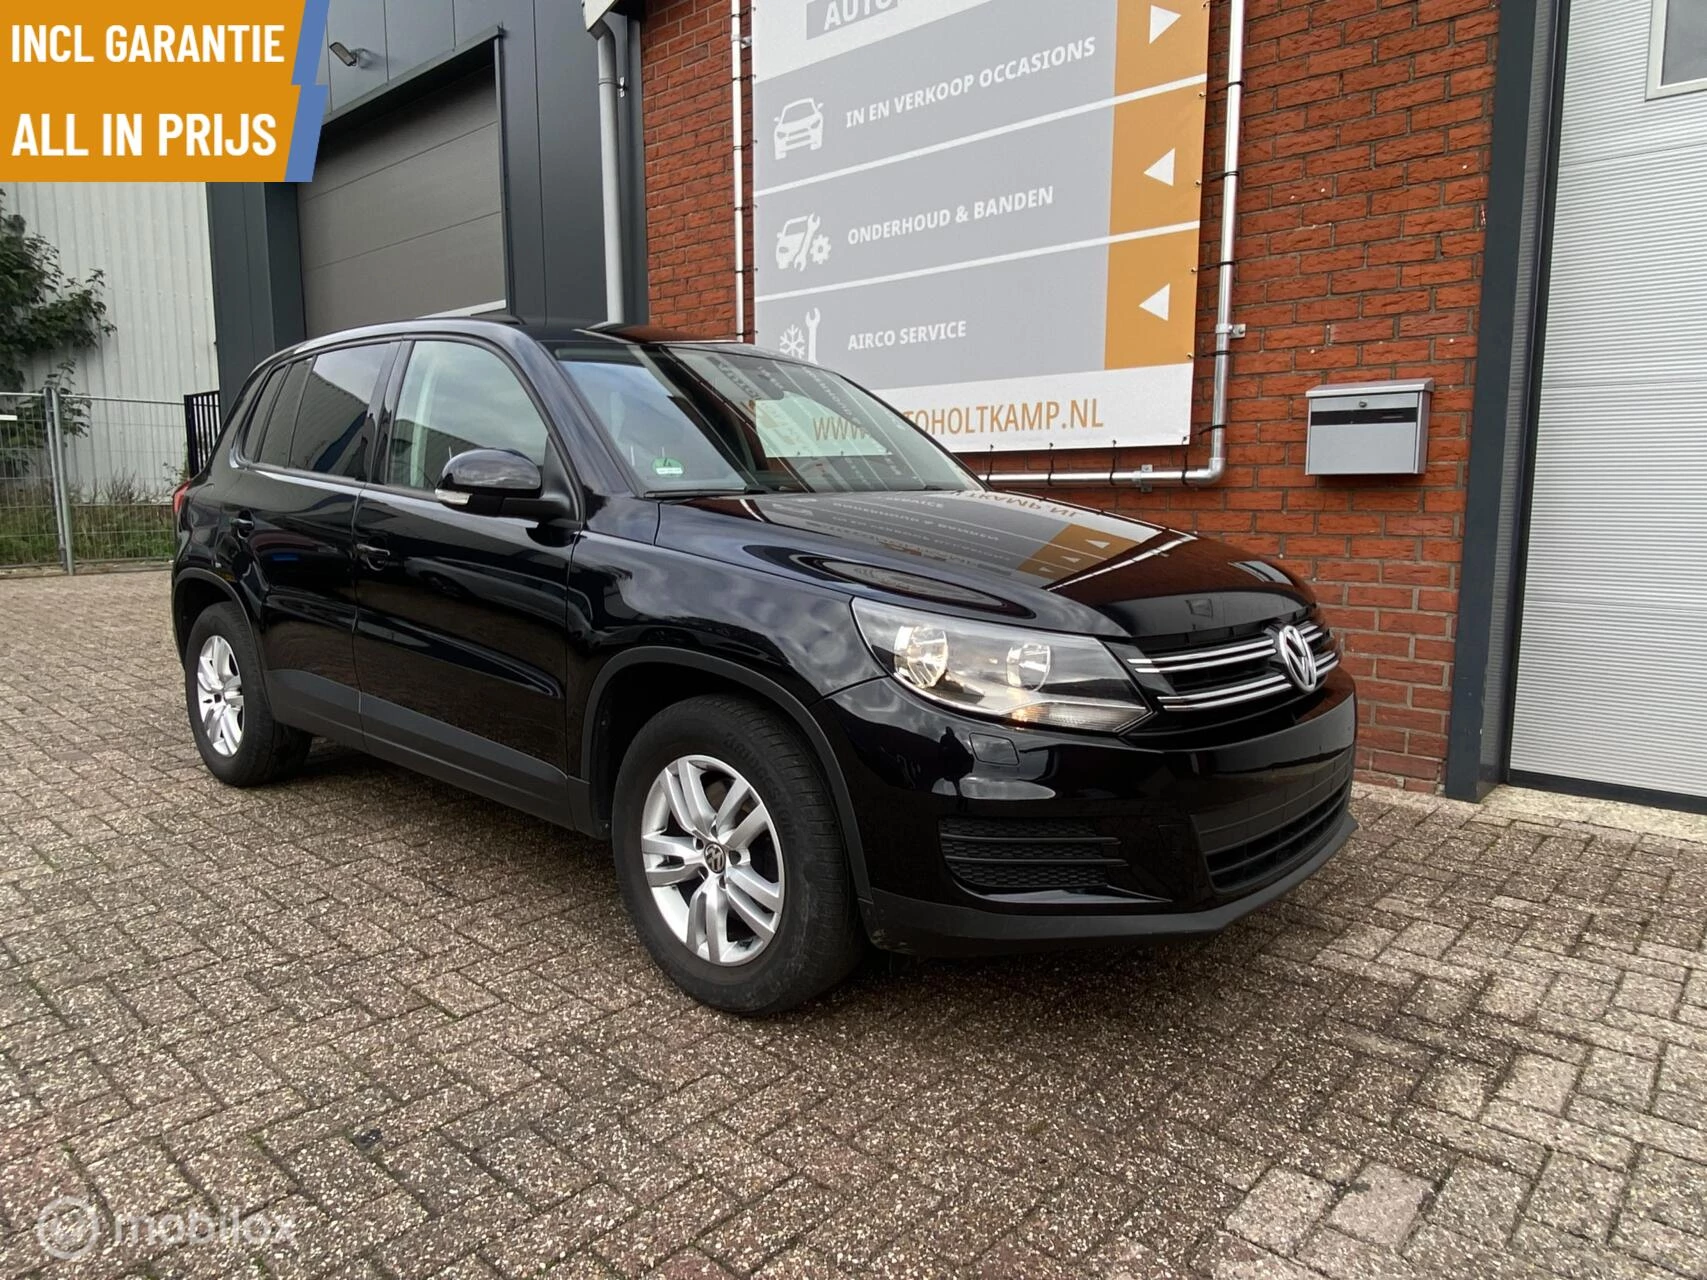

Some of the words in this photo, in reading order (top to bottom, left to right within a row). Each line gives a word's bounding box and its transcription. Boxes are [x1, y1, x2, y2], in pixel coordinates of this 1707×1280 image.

[846, 107, 865, 128] IN
[869, 99, 890, 121] EN
[894, 74, 974, 113] VERKOOP
[979, 36, 1096, 88] OCCASIONS
[847, 208, 950, 245] ONDERHOUD
[955, 205, 969, 223] &
[973, 186, 1054, 219] BANDEN
[847, 329, 896, 351] AIRCO
[899, 320, 967, 344] SERVICE
